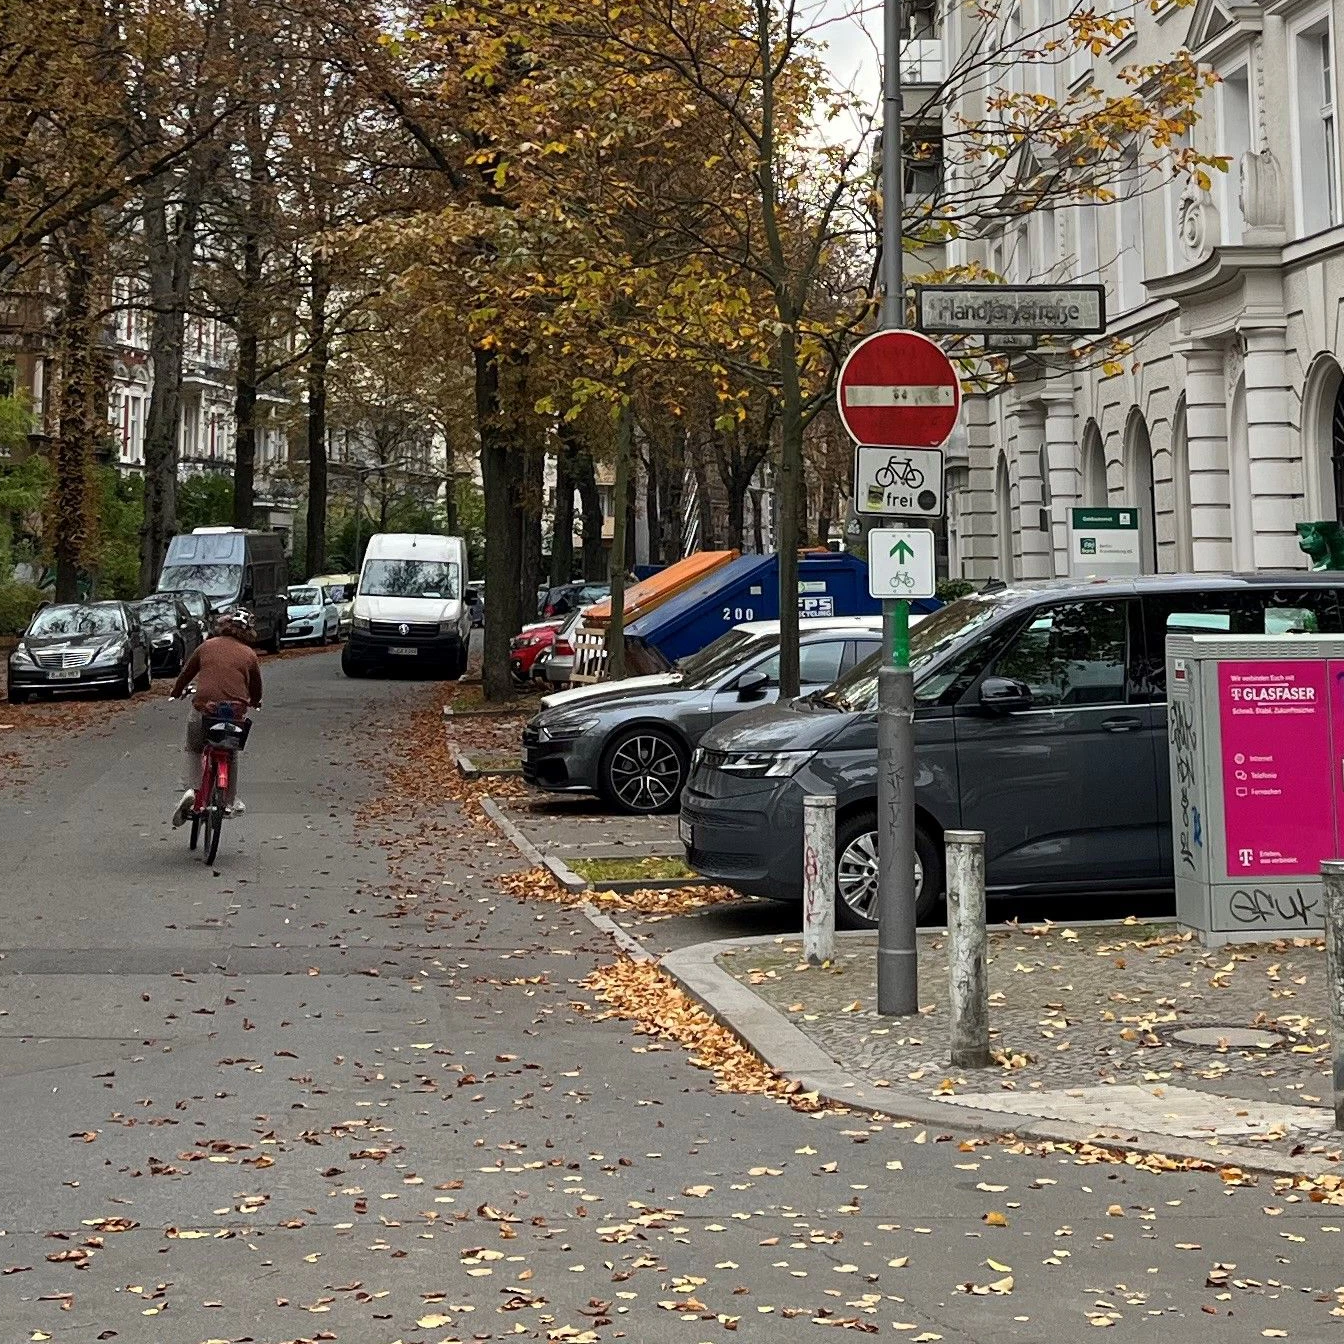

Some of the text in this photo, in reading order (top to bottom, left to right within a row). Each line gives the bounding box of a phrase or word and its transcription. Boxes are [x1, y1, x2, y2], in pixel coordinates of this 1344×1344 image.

[886, 492, 913, 507] frei
[722, 607, 754, 620] 200
[1242, 687, 1315, 701] GLASFASER
